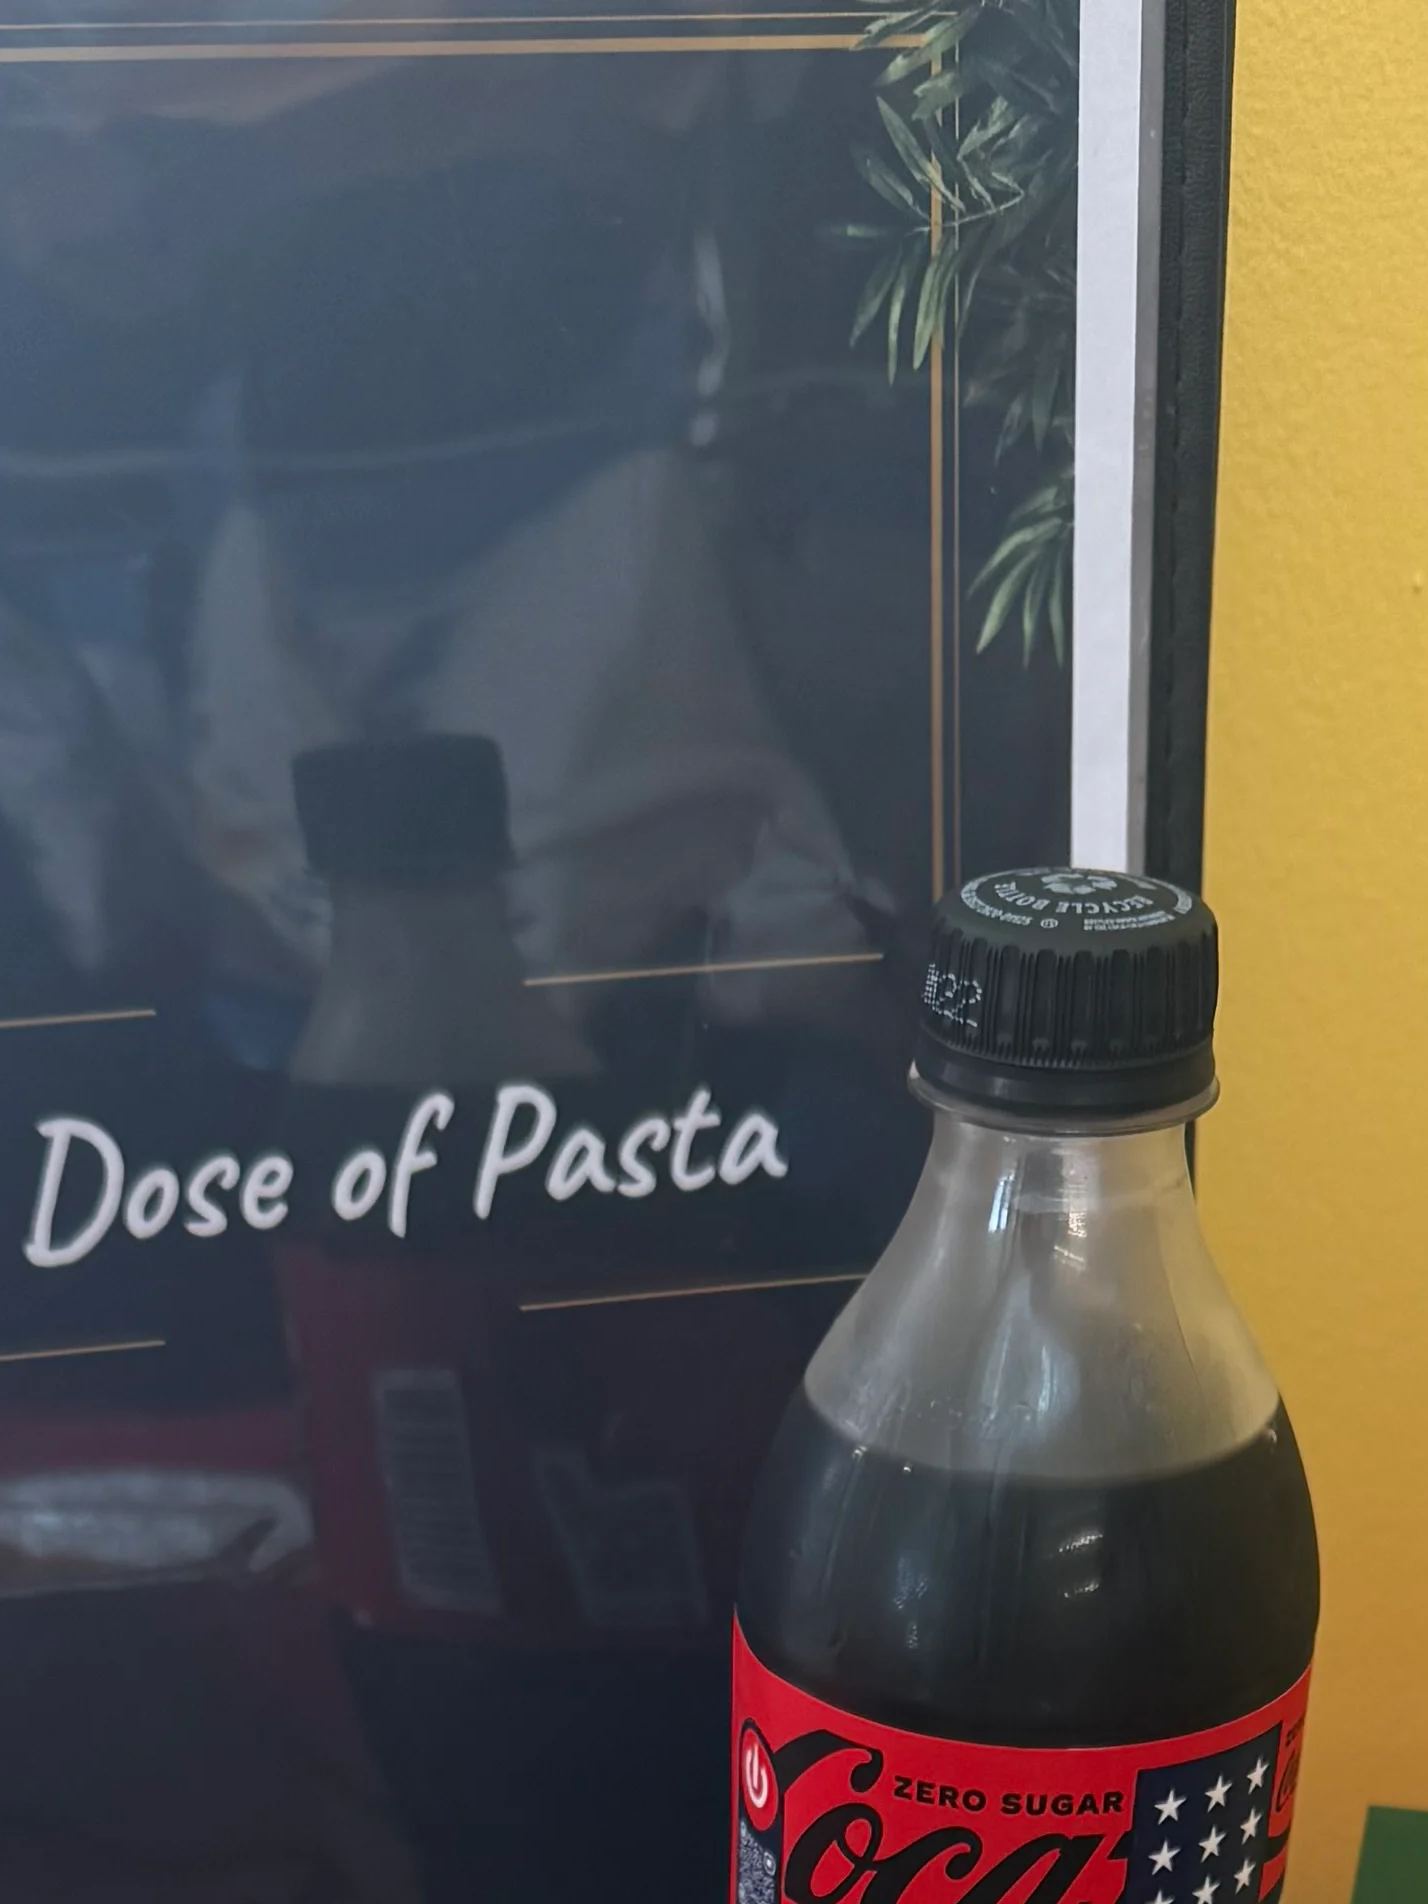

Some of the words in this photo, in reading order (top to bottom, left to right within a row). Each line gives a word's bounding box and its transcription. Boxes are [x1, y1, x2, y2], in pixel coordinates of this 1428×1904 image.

[24, 1116, 295, 1269] Dose
[332, 1091, 454, 1239] of
[475, 1083, 788, 1221] Pasta
[893, 1775, 988, 1813] ZERO
[1000, 1790, 1125, 1817] SUGAR
